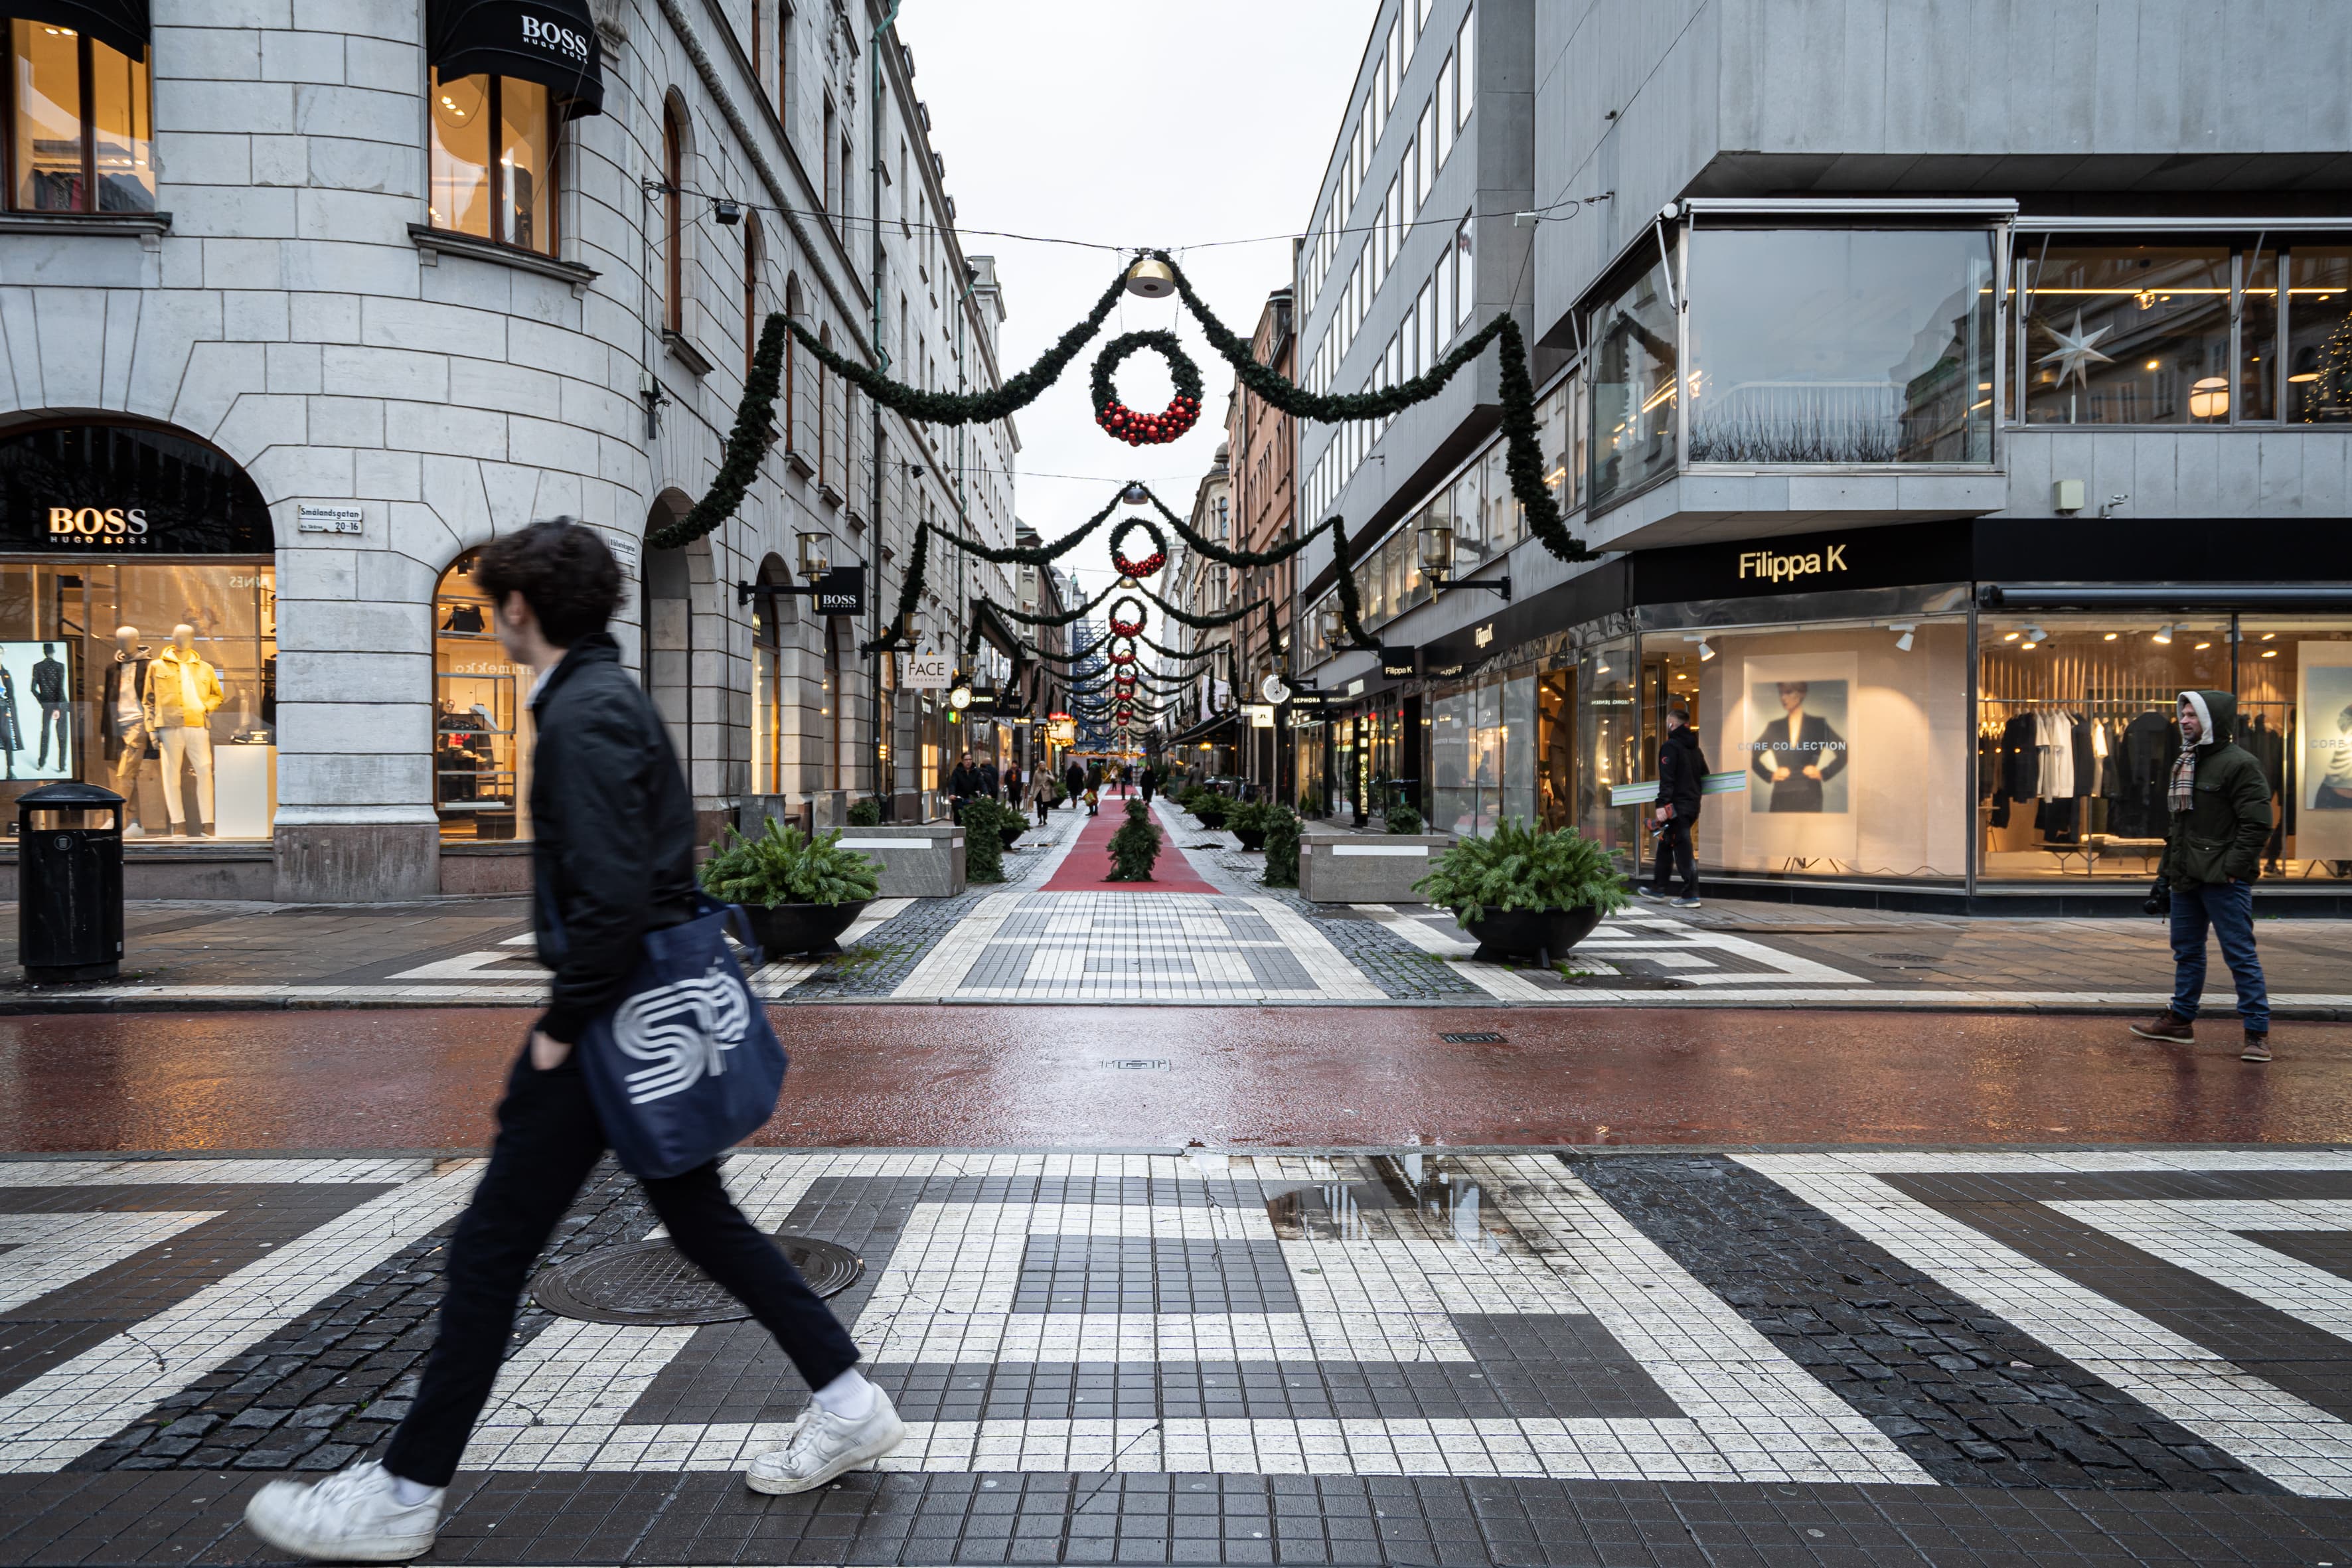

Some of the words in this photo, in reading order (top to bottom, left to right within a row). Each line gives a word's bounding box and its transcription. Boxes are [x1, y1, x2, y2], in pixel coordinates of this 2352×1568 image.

[521, 15, 588, 56] BOSS
[523, 37, 556, 50] HUGO
[301, 508, 359, 519] Smålandsgatan
[49, 507, 149, 534] BOSS
[104, 536, 147, 544] BOSS
[1739, 551, 1821, 583] Filippa
[1828, 544, 1847, 572] K
[823, 595, 856, 605] BOSS
[1476, 627, 1488, 649] Filippa
[909, 663, 945, 676] FACE
[1385, 666, 1406, 676] Filippa
[1737, 742, 1768, 751] CORE
[1772, 742, 1846, 751] COLLECTION
[2310, 739, 2346, 749] CORE
